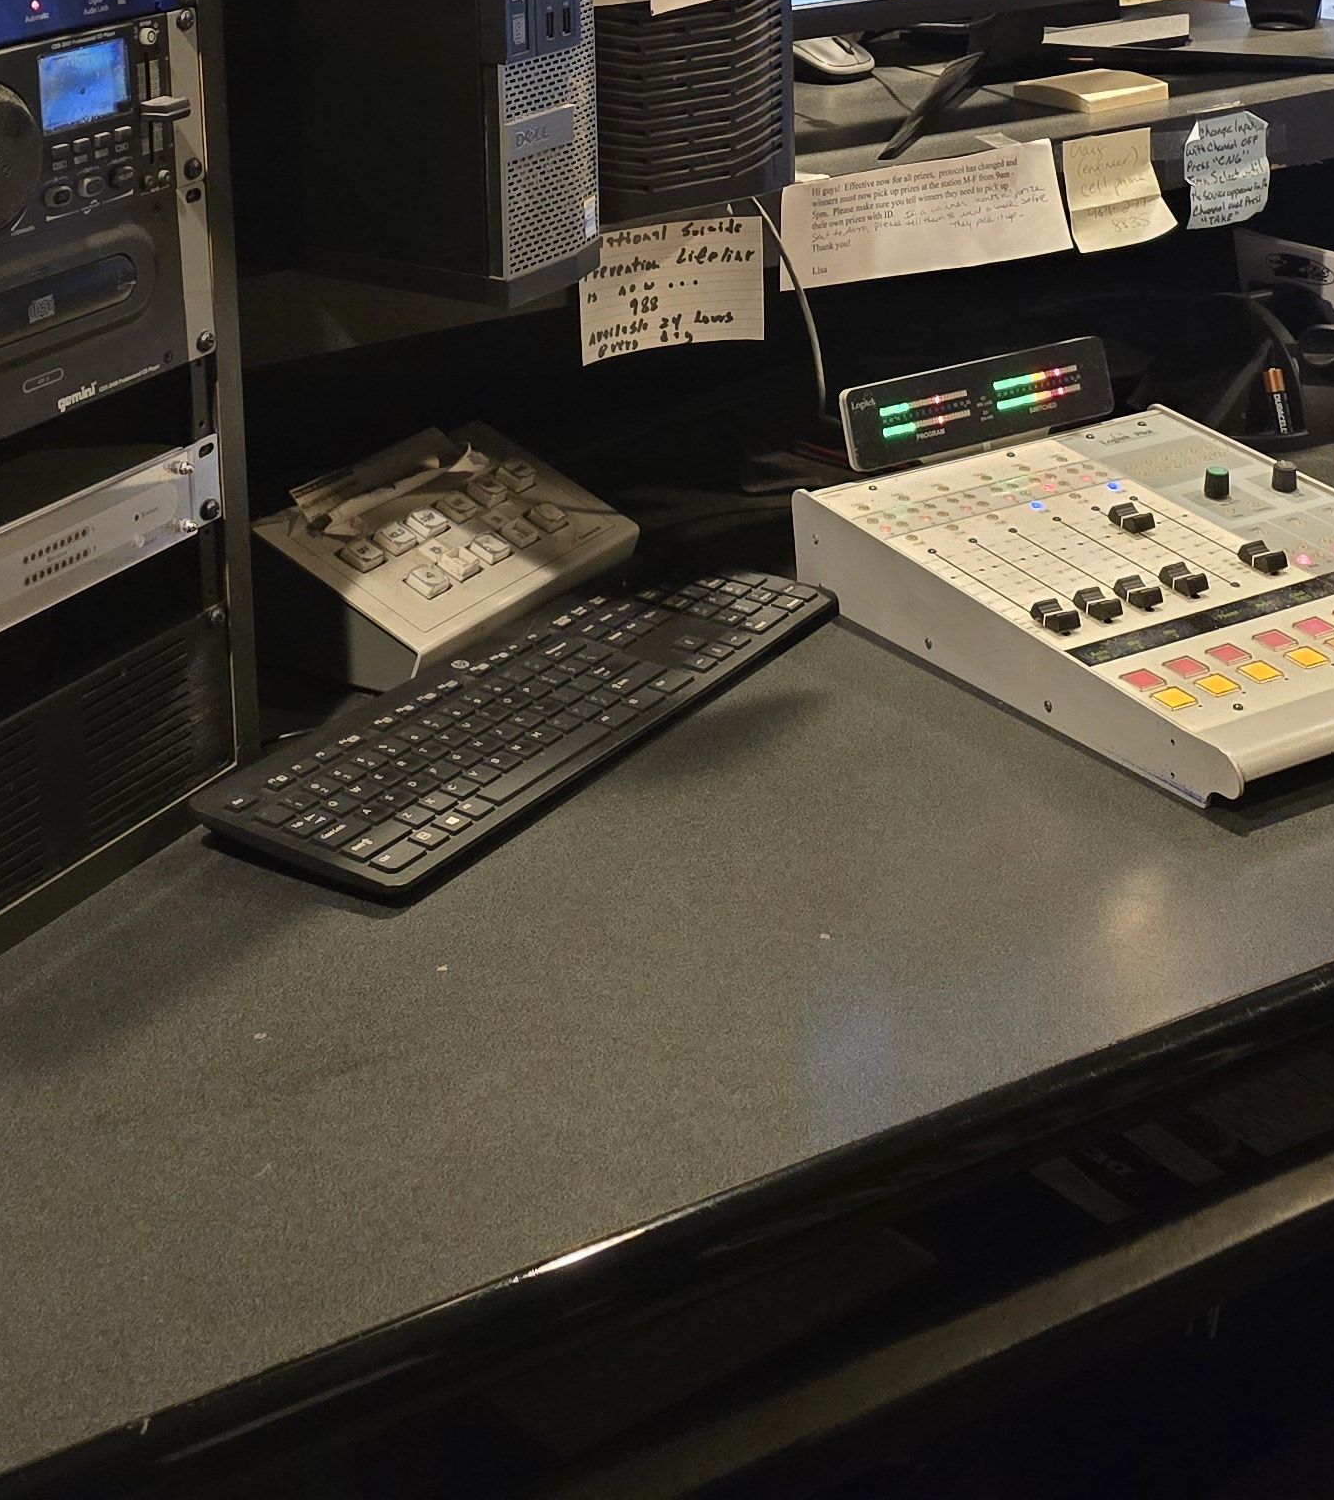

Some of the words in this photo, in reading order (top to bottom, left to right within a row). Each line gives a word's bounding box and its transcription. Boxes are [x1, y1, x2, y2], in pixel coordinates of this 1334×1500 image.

[25, 11, 49, 24] Automatic
[515, 124, 549, 149] DELL
[812, 187, 820, 196] Hi
[822, 185, 841, 197] guys!
[844, 181, 874, 192] Effective
[876, 178, 890, 187] now
[892, 175, 903, 184] for
[904, 174, 912, 182] all
[914, 171, 935, 183] prizes,
[938, 166, 965, 179] protocol
[966, 164, 976, 173] has
[978, 160, 1004, 174] changed
[1006, 157, 1017, 168] and
[812, 242, 833, 253] Thank
[835, 240, 850, 251] you!
[812, 266, 827, 275] Lisa
[630, 296, 658, 316] 988
[659, 314, 682, 330] 24
[917, 429, 945, 440] PROGRAM
